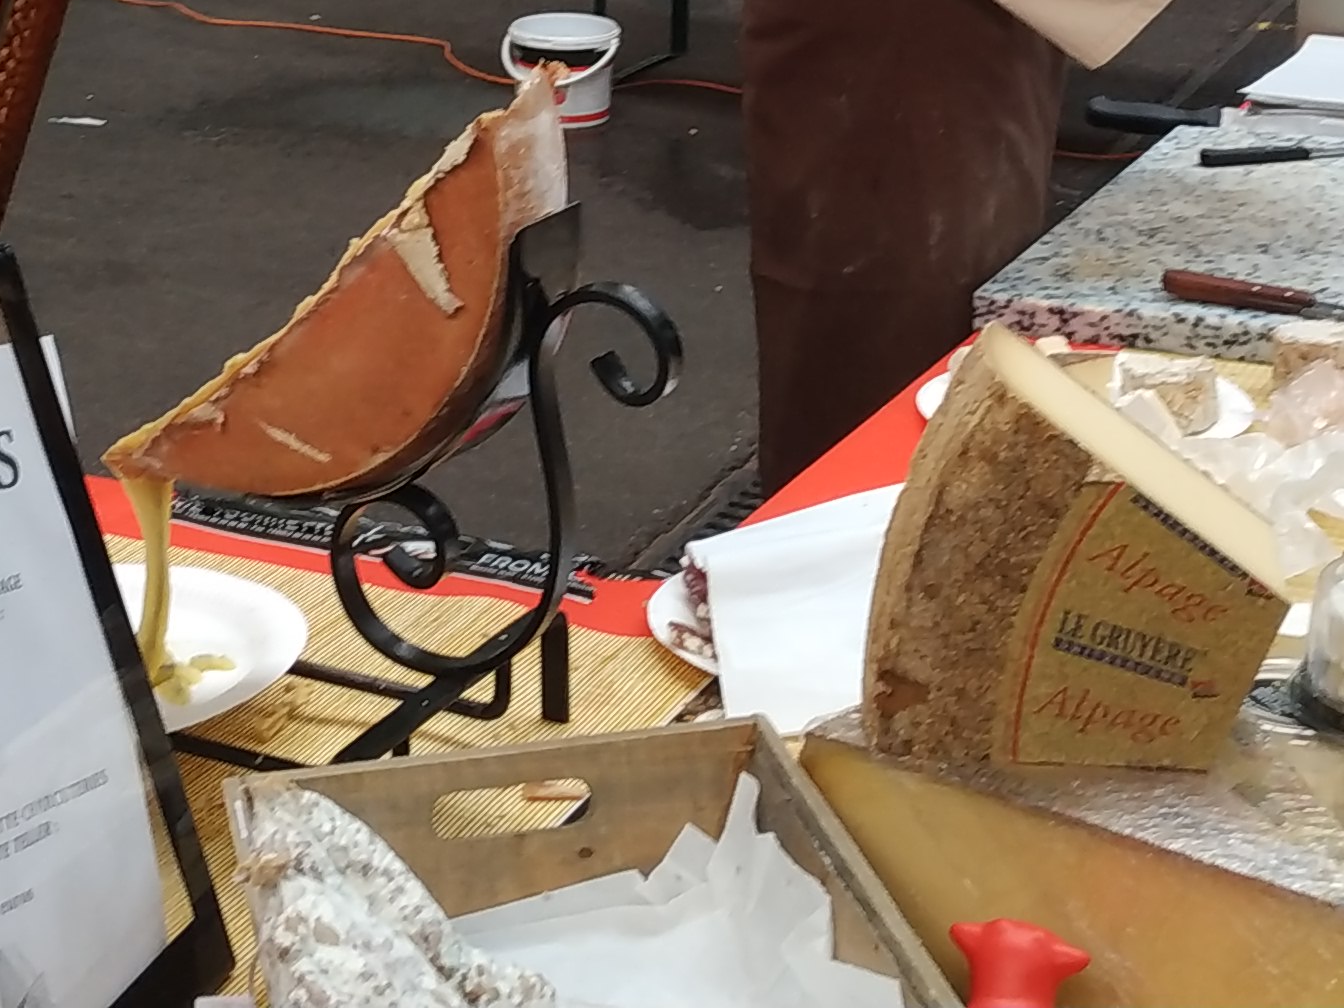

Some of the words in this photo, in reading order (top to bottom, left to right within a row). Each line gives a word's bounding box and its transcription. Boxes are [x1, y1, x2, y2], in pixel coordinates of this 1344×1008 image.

[1089, 542, 1229, 625] Alpage
[1058, 609, 1088, 640] LE
[1033, 685, 1181, 744] Alpage
